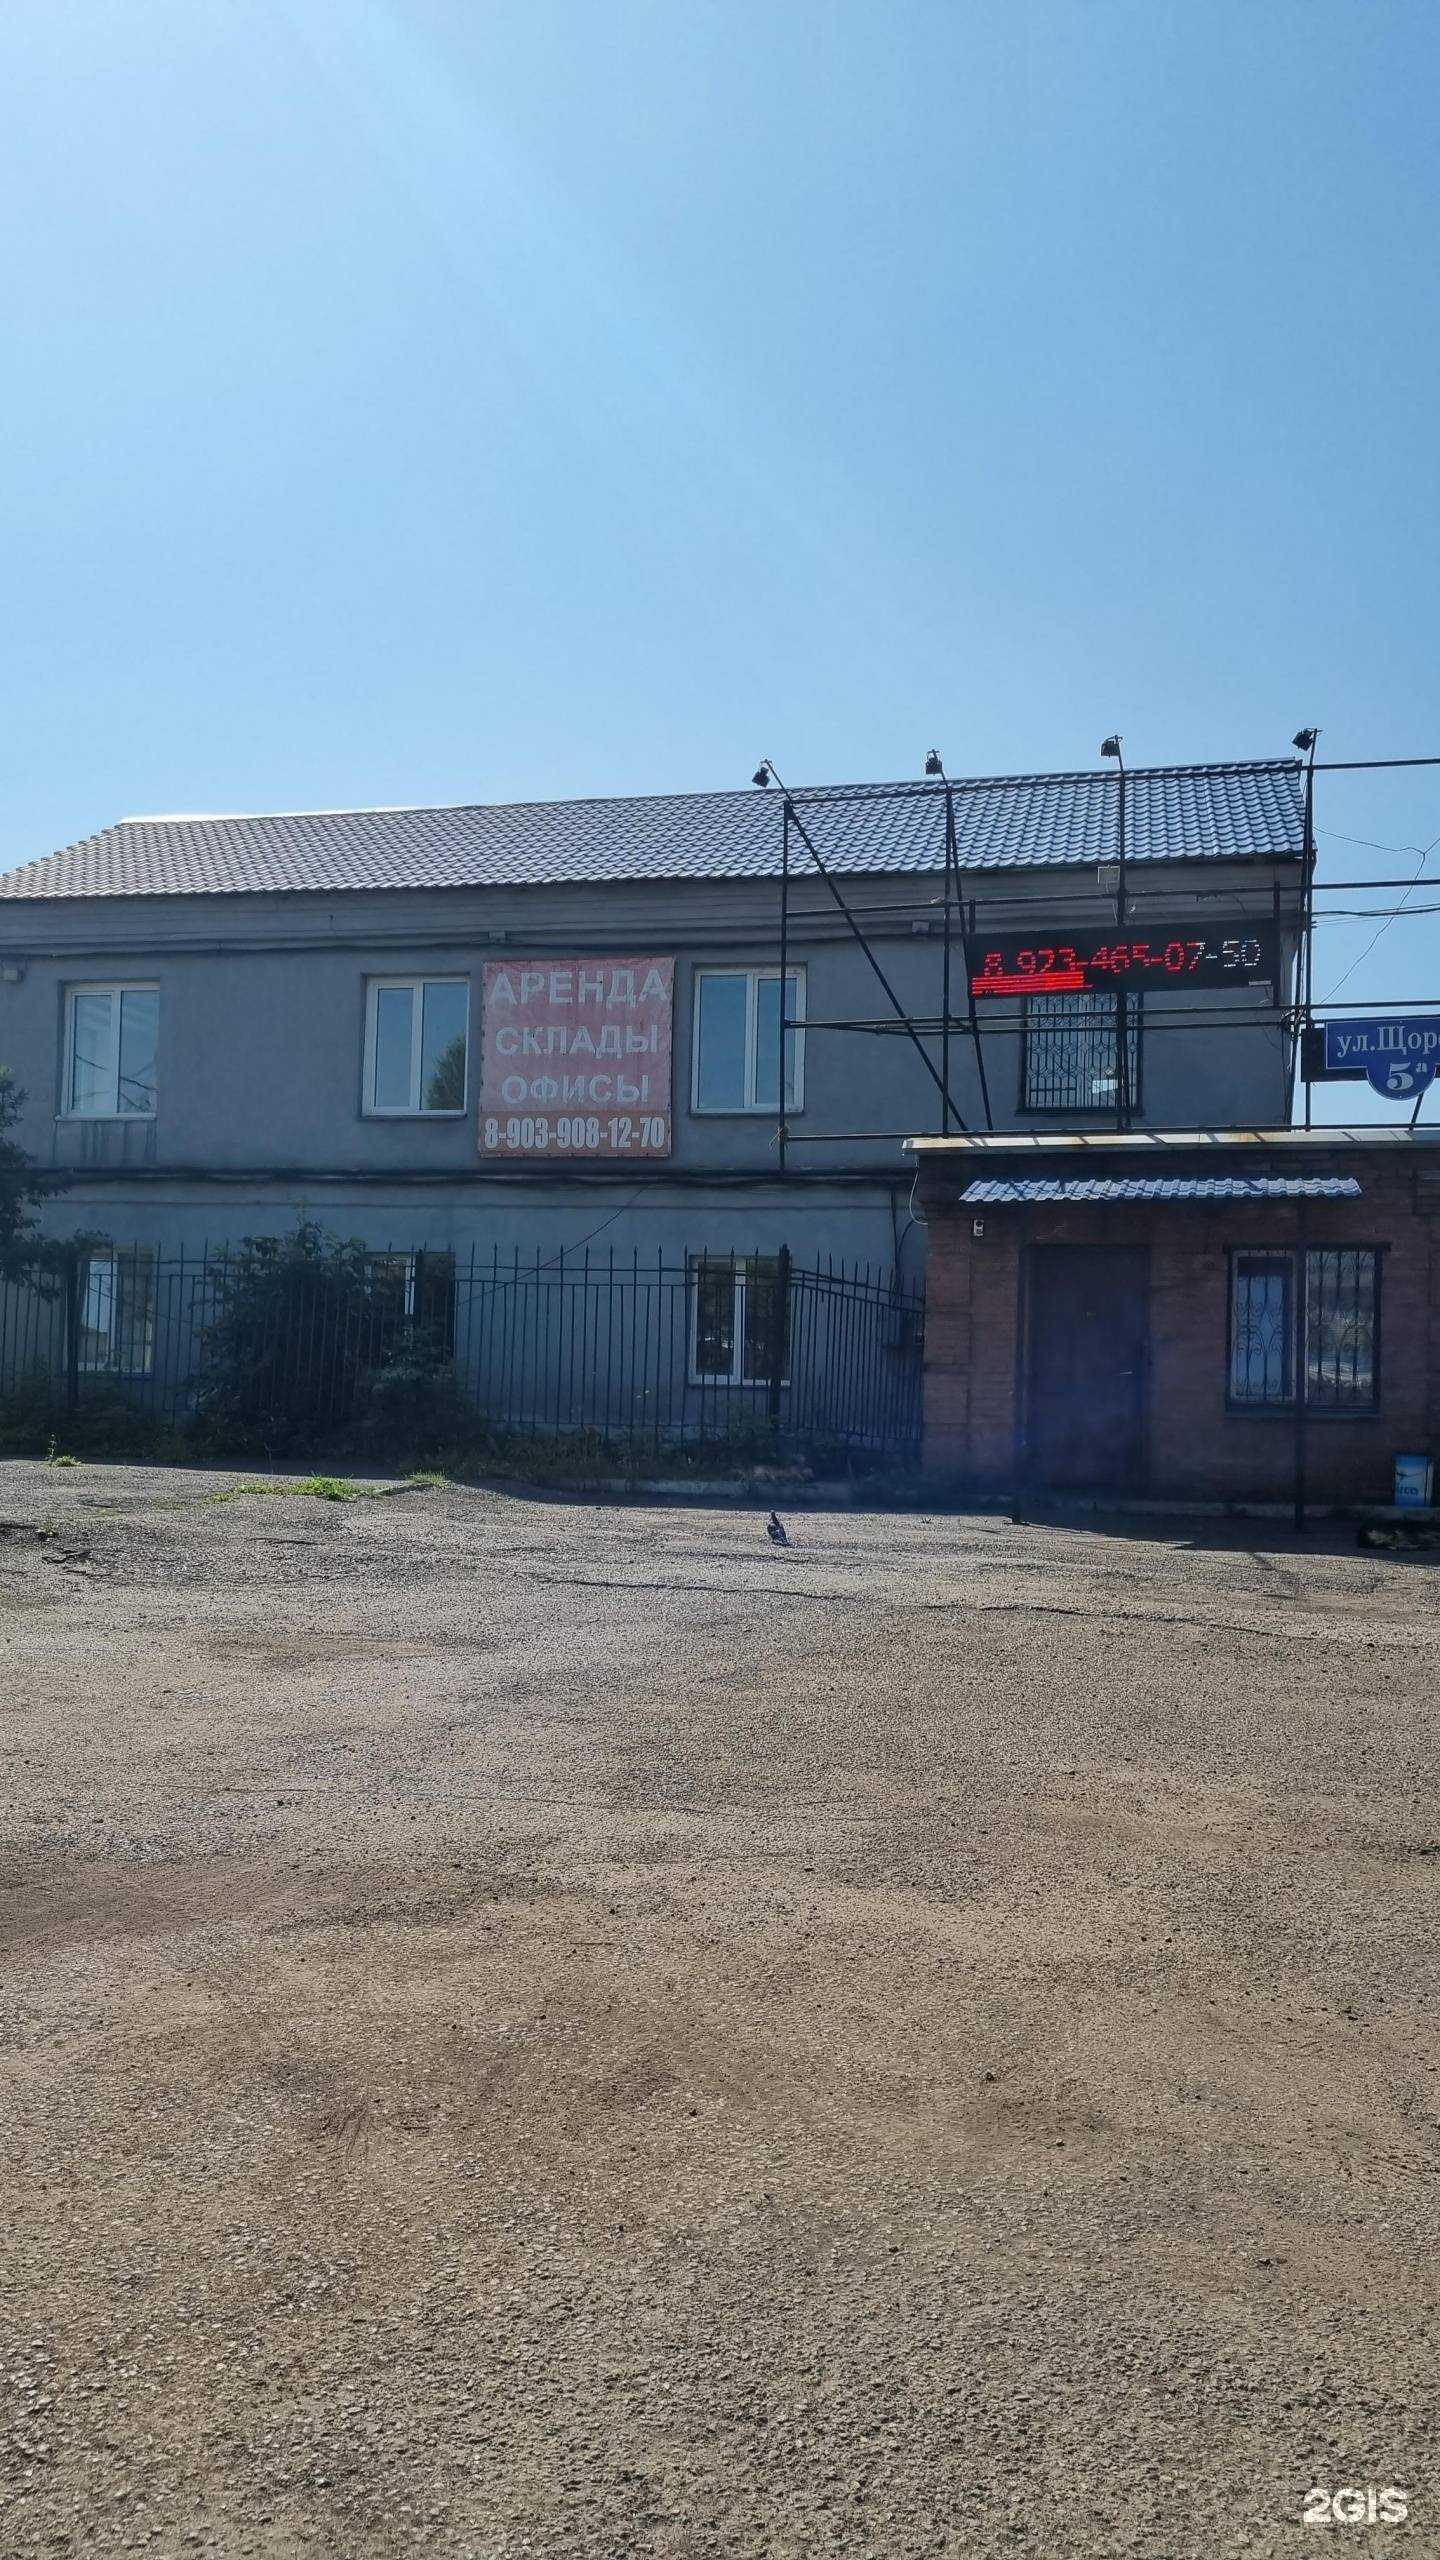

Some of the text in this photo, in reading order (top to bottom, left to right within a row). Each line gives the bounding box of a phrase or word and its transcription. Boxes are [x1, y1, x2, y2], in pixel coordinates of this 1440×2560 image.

[488, 968, 668, 1009] АРЕНДА
[495, 1024, 659, 1059] СКЛАДЫ
[1337, 1025, 1440, 1058] ул.Щор
[501, 1074, 649, 1104] ОФИСЫ
[484, 1116, 666, 1149] 8-903-908-12-70
